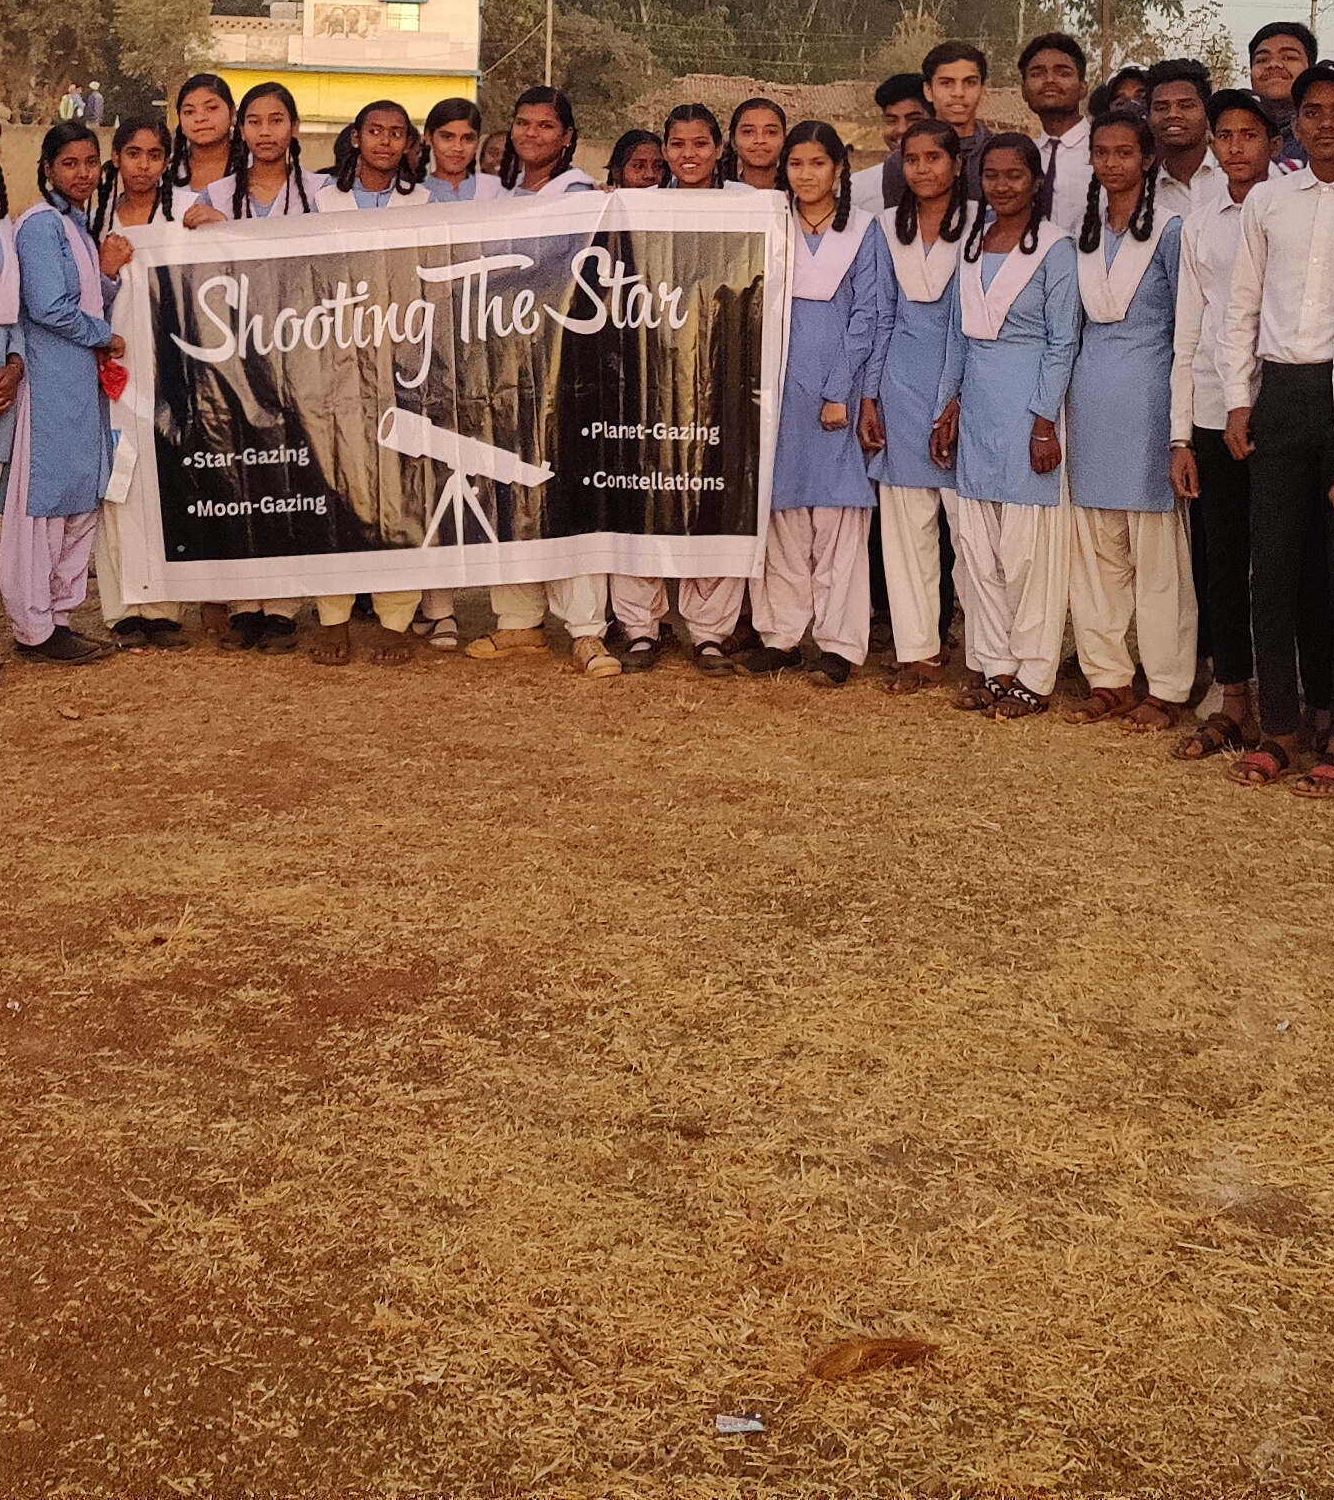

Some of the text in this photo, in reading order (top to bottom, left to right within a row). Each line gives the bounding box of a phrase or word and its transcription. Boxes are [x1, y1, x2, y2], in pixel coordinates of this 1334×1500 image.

[170, 246, 689, 389] Shooting The Star
[591, 420, 720, 445] Planet-Gazing
[193, 444, 310, 469] Star-Gazing
[593, 471, 724, 491] Constellations
[197, 493, 327, 518] Moon-Gazing
